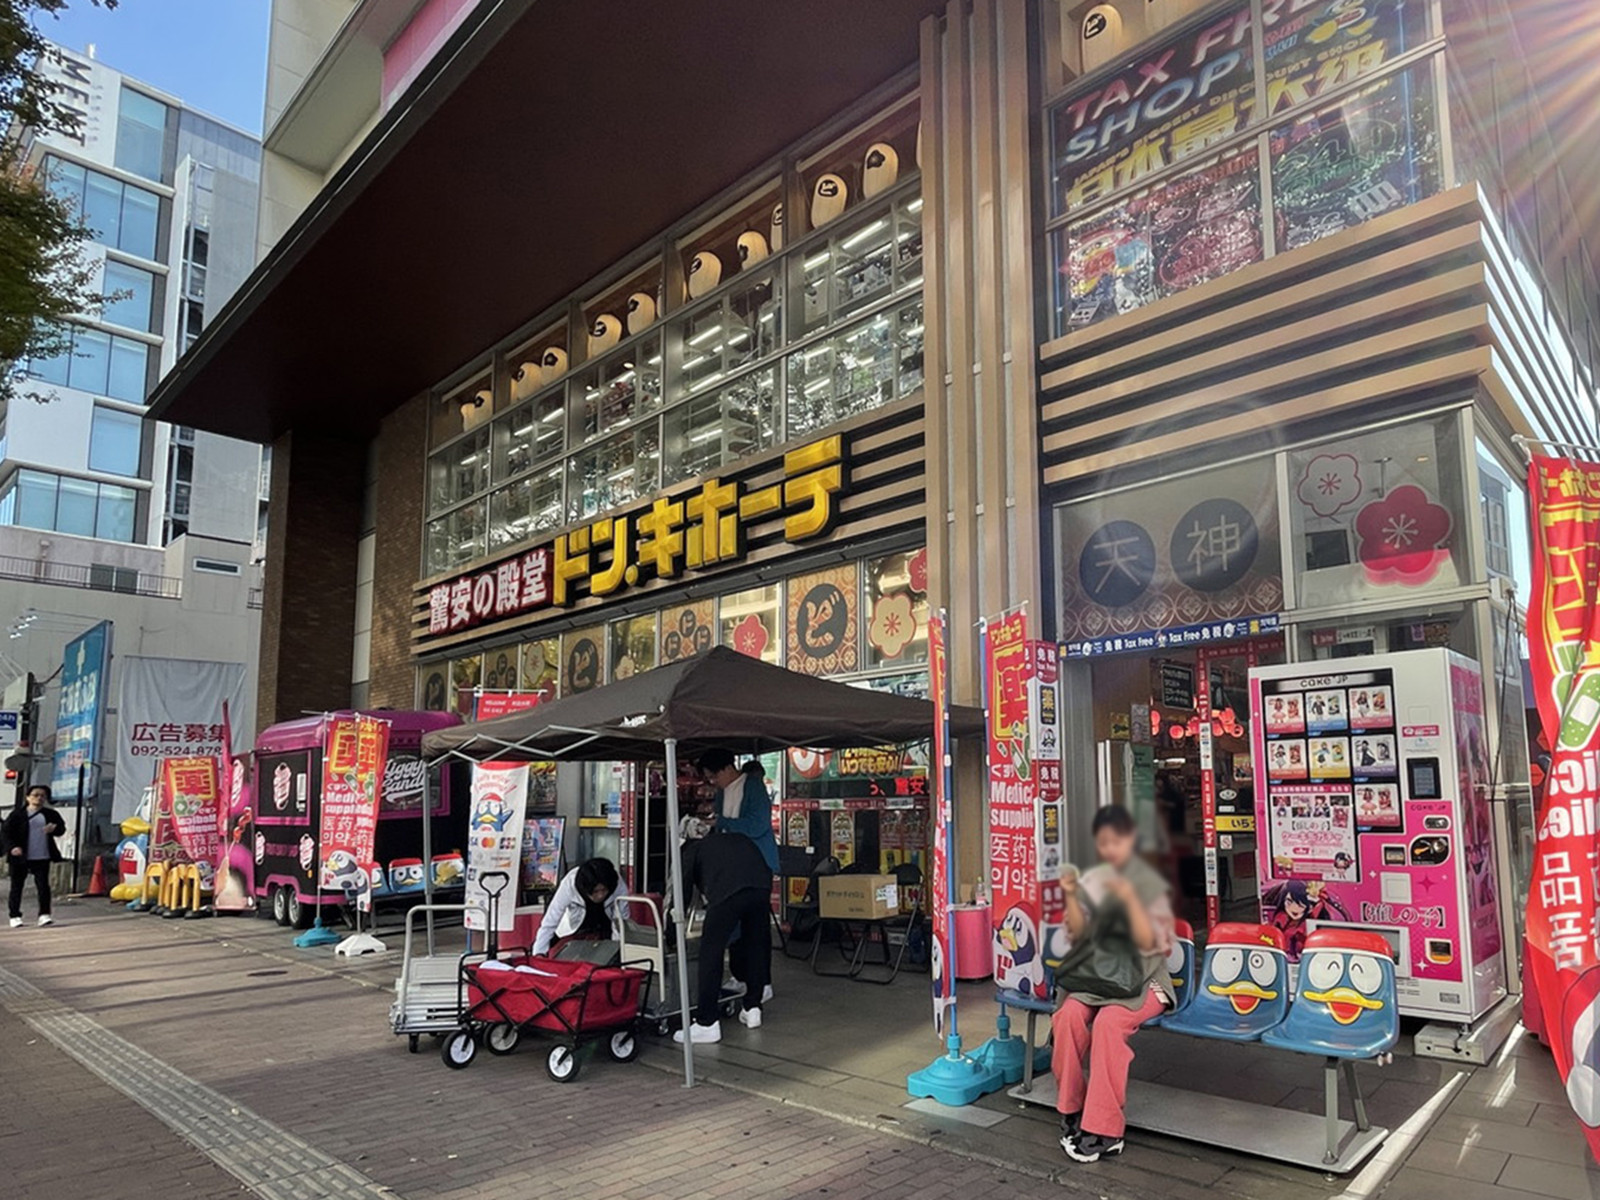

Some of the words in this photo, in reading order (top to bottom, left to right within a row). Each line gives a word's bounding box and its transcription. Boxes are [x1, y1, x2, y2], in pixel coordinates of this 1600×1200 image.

[1064, 51, 1240, 163] SHOP
[1066, 49, 1176, 131] TAX
[429, 548, 547, 634] 驚安の殿堂
[132, 722, 225, 743] 広告募集
